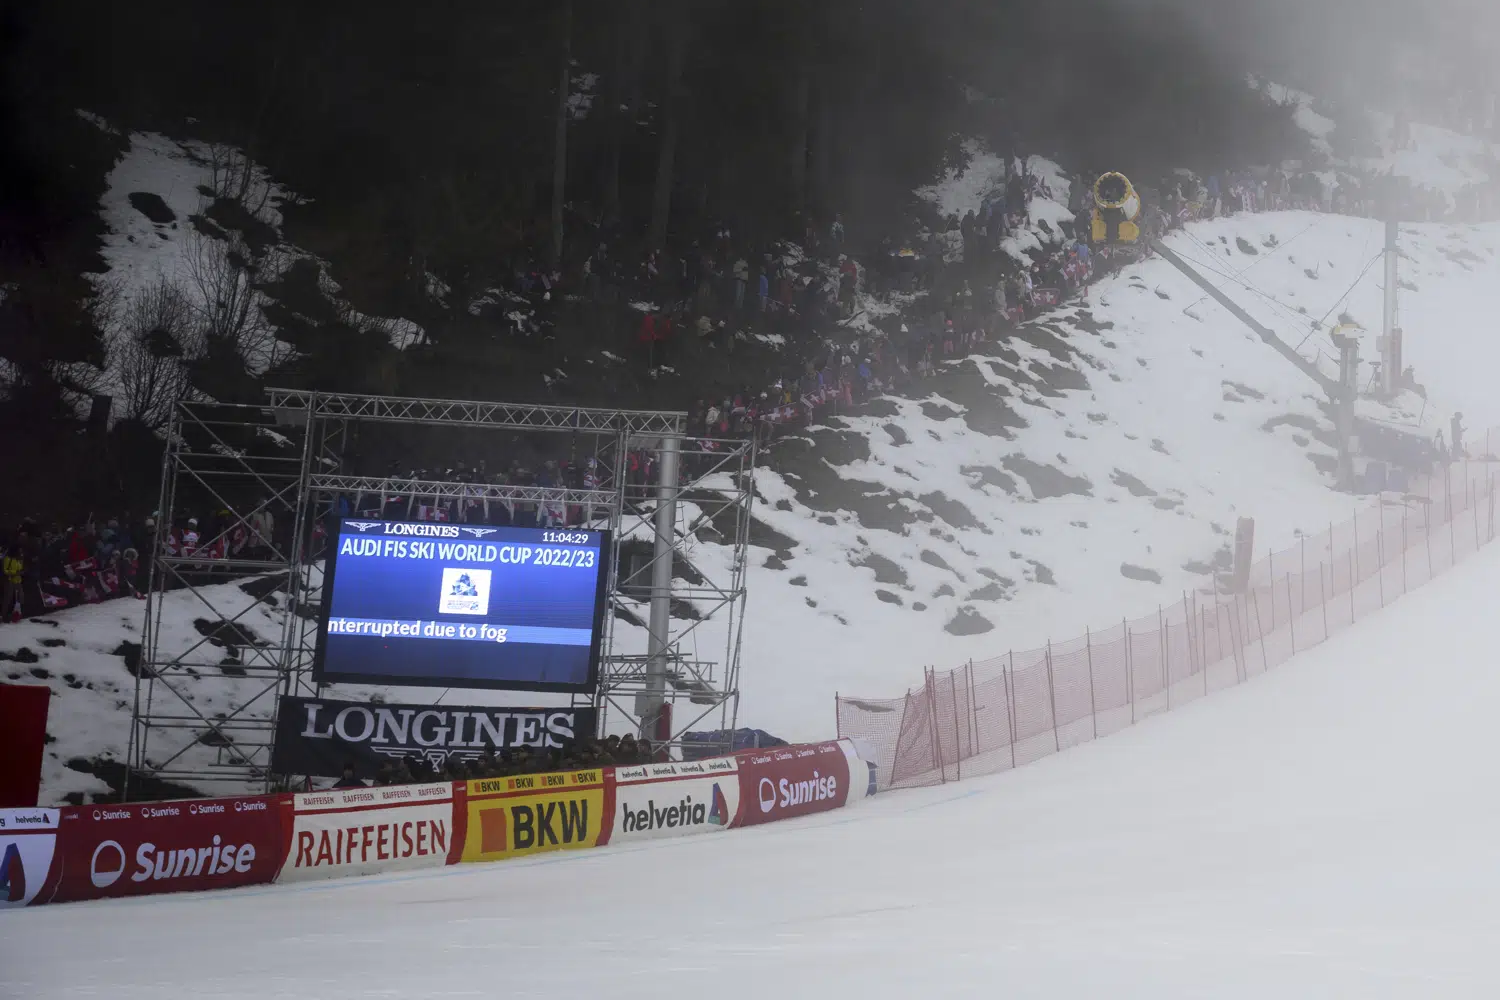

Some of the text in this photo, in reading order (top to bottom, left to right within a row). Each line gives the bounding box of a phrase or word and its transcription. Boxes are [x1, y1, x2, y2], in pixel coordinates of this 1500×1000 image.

[384, 522, 460, 538] LONGINES
[542, 532, 589, 544] 11:04:29
[340, 538, 595, 568] AUDI FIS SKI WORLD CUP 2022/23
[424, 620, 456, 637] due
[459, 623, 477, 639] to
[480, 623, 508, 643] fog
[301, 703, 576, 748] LONGINES
[481, 772, 596, 792] BKW BKW BKW BKW
[779, 771, 836, 808] Sunrise
[303, 787, 446, 805] RAIFFEISEN RAIFFEISEN RAIFFEISEN RAIFFEISEN
[15, 814, 41, 824] helvetia
[103, 801, 267, 820] Sunrise Sunrise Sunrise Sunrise
[623, 795, 705, 832] helvetia
[511, 799, 588, 850] BKW
[295, 819, 446, 868] RAIFFEISEN
[131, 835, 256, 882] Sunrise
